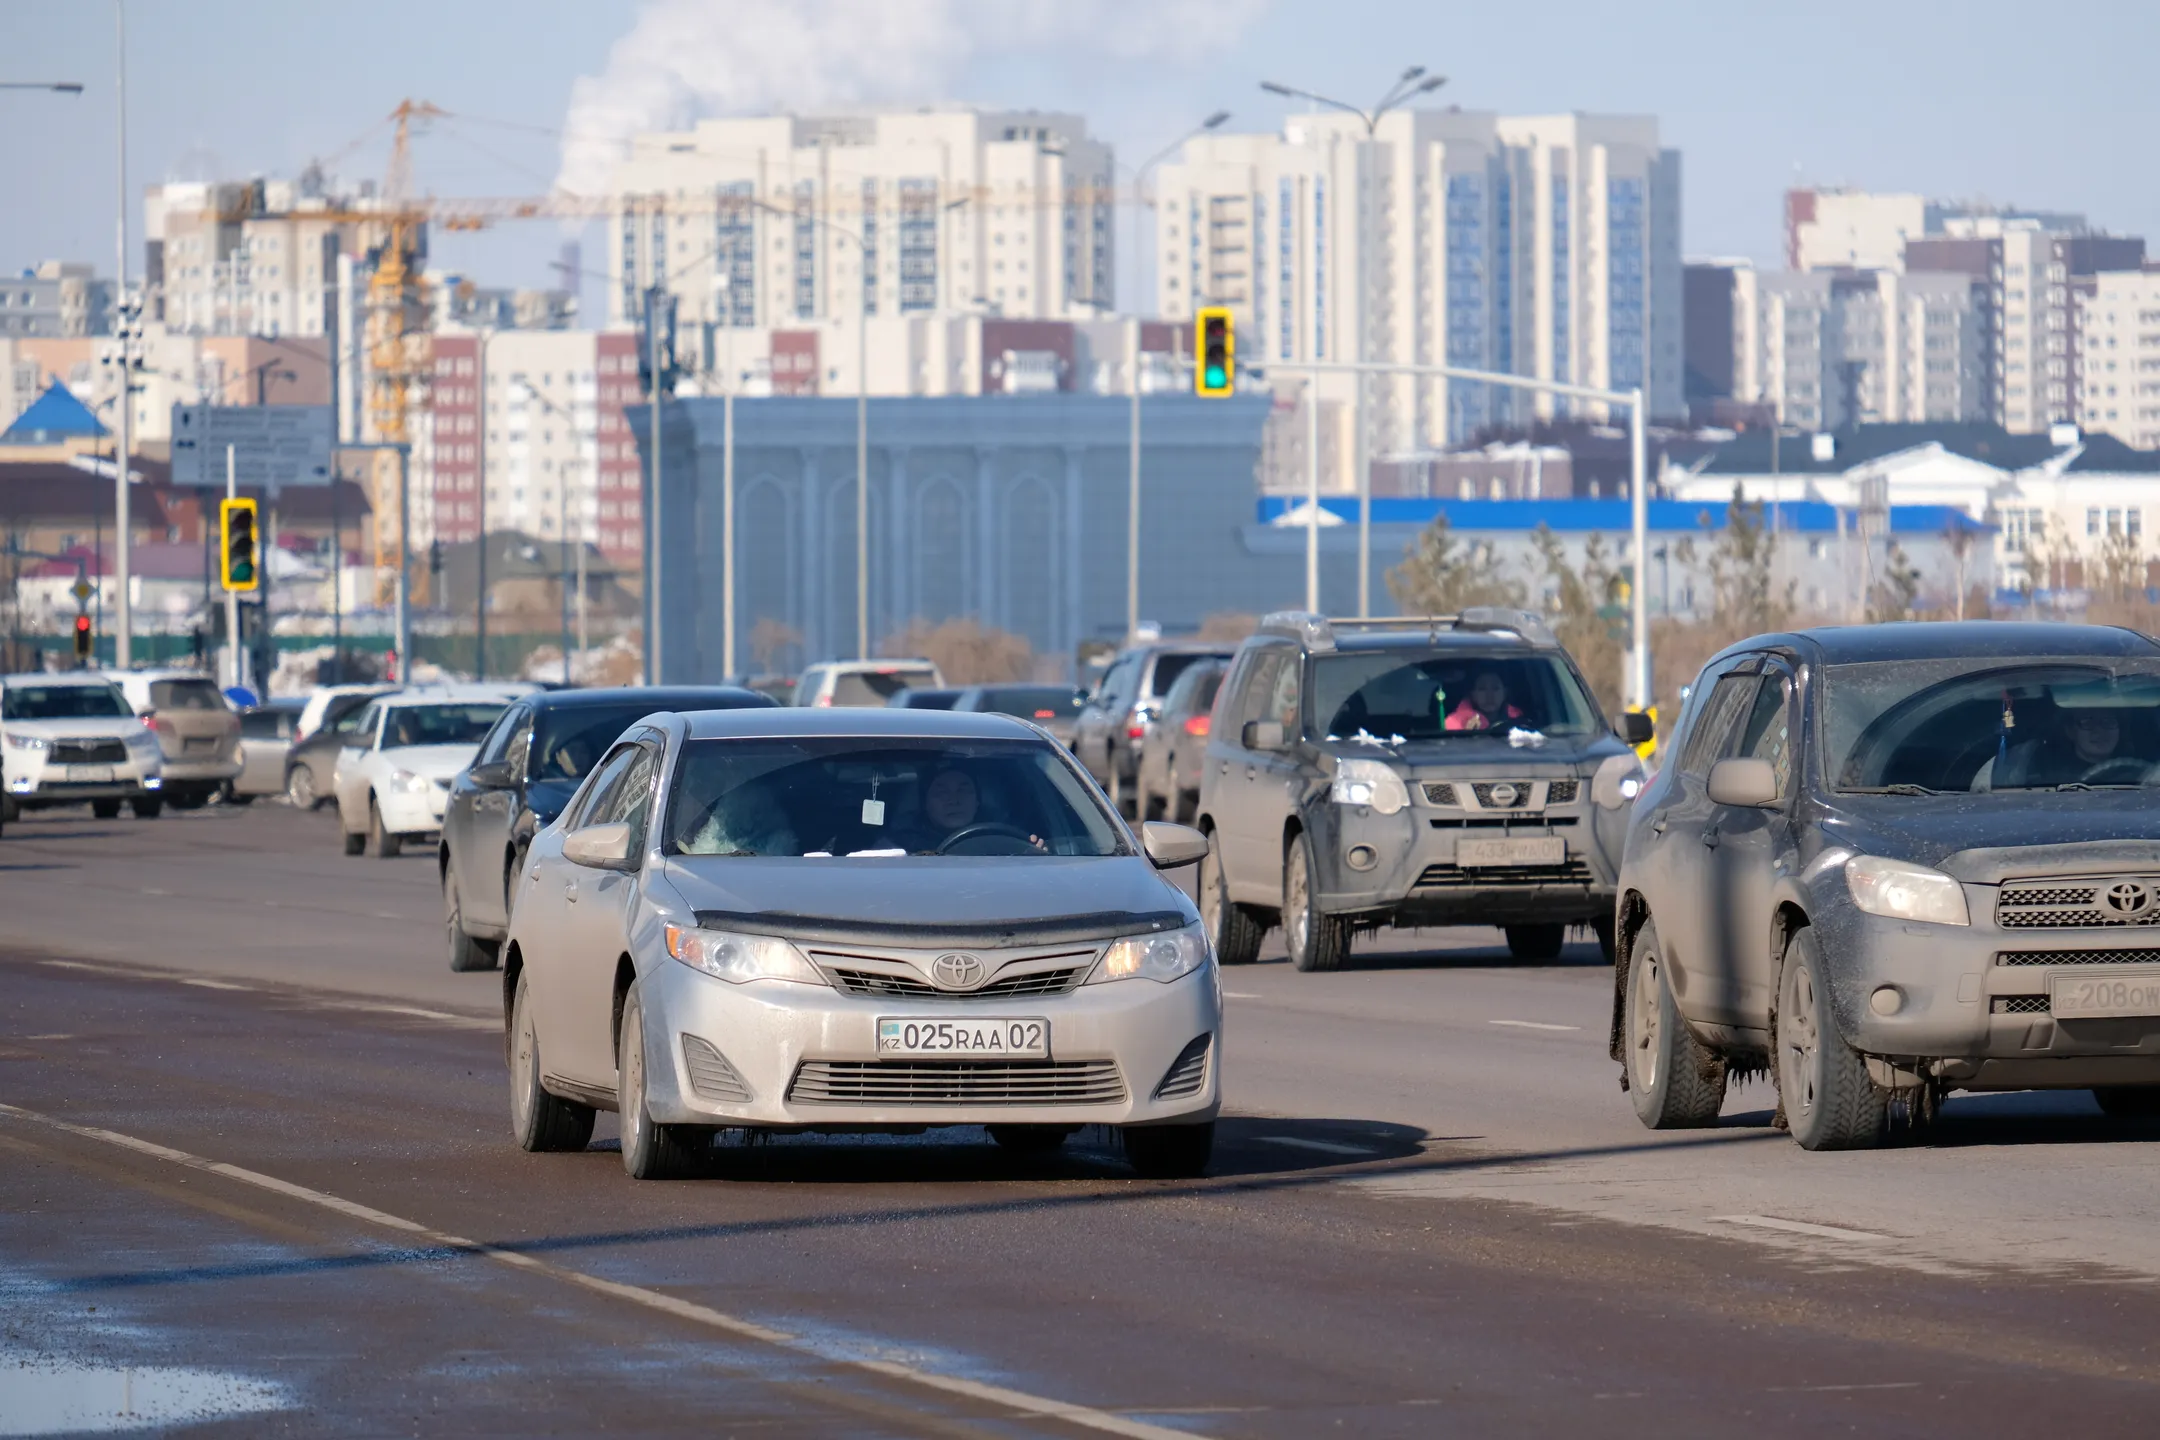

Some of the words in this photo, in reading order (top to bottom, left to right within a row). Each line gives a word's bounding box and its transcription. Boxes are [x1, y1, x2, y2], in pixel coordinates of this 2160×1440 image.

[881, 1038, 901, 1050] KZ
[904, 1023, 1003, 1050] 025RAA
[1009, 1023, 1042, 1050] 02
